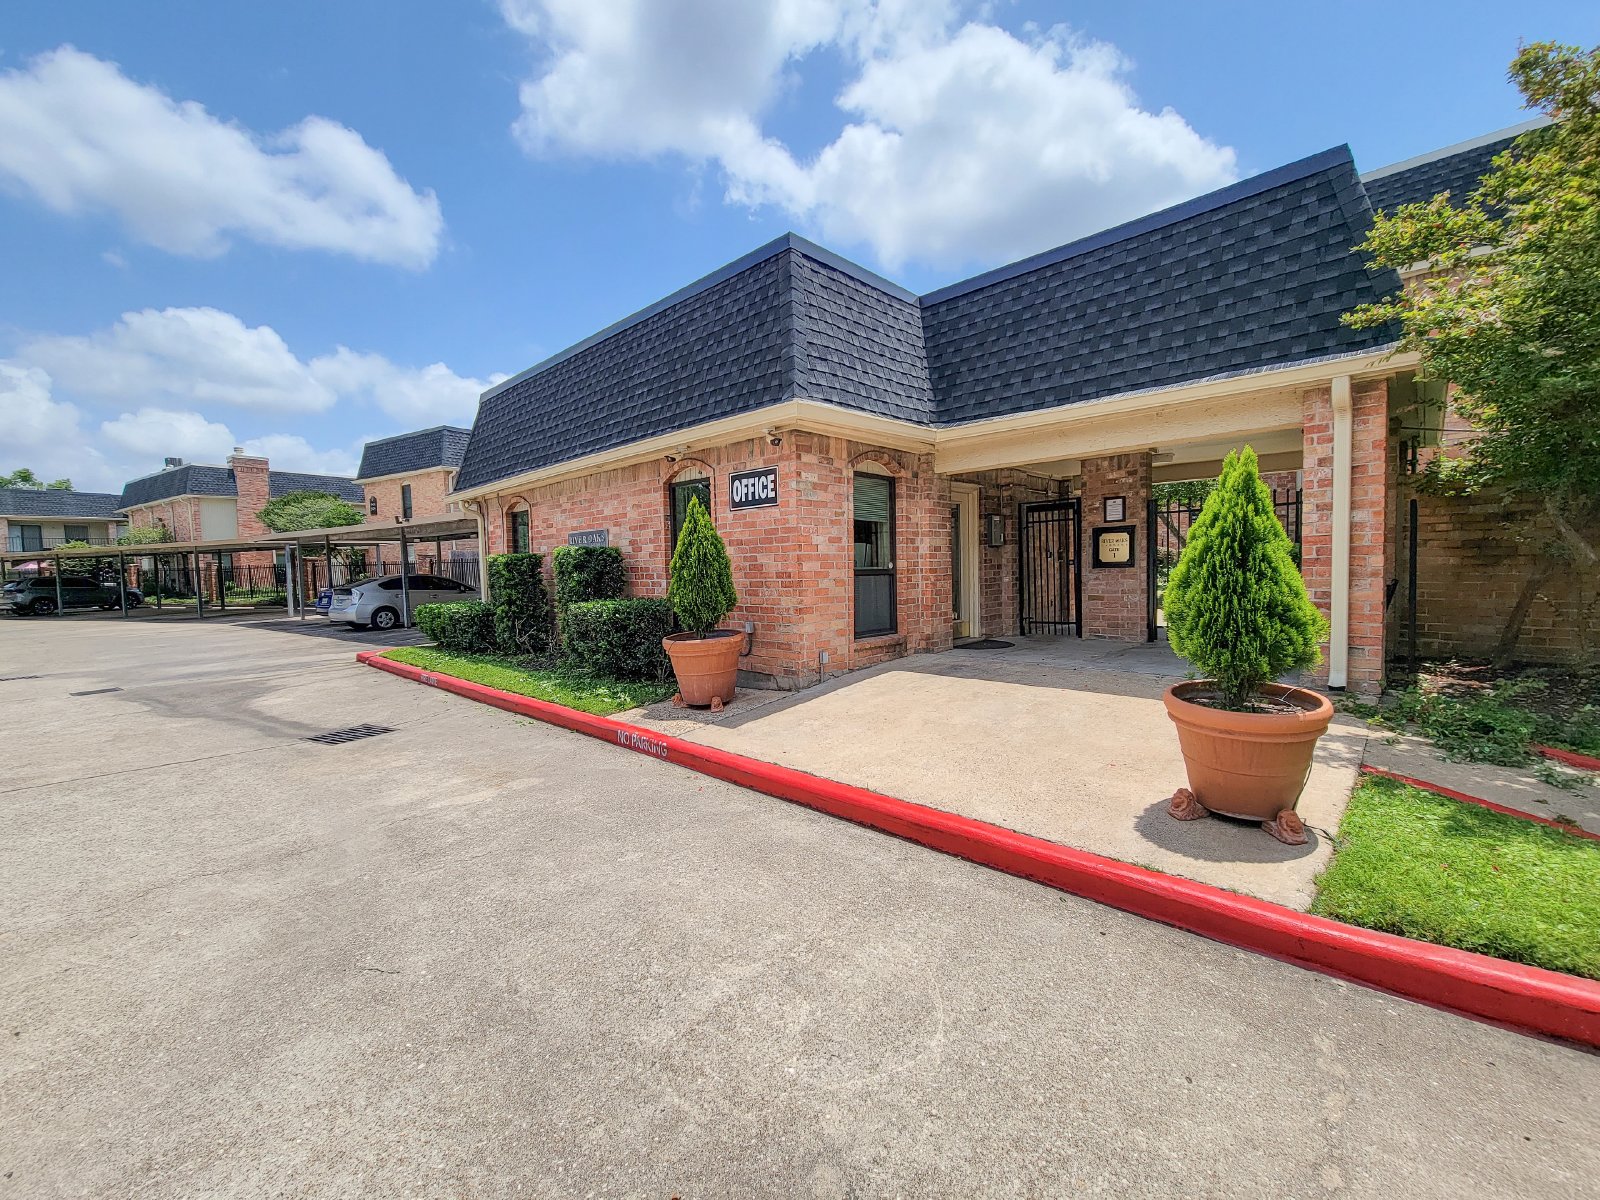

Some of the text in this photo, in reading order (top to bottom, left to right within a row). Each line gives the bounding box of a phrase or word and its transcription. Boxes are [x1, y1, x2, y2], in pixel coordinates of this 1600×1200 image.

[733, 474, 775, 502] OFFICE
[588, 533, 605, 543] OAKS
[617, 730, 668, 757] NO PARKING
